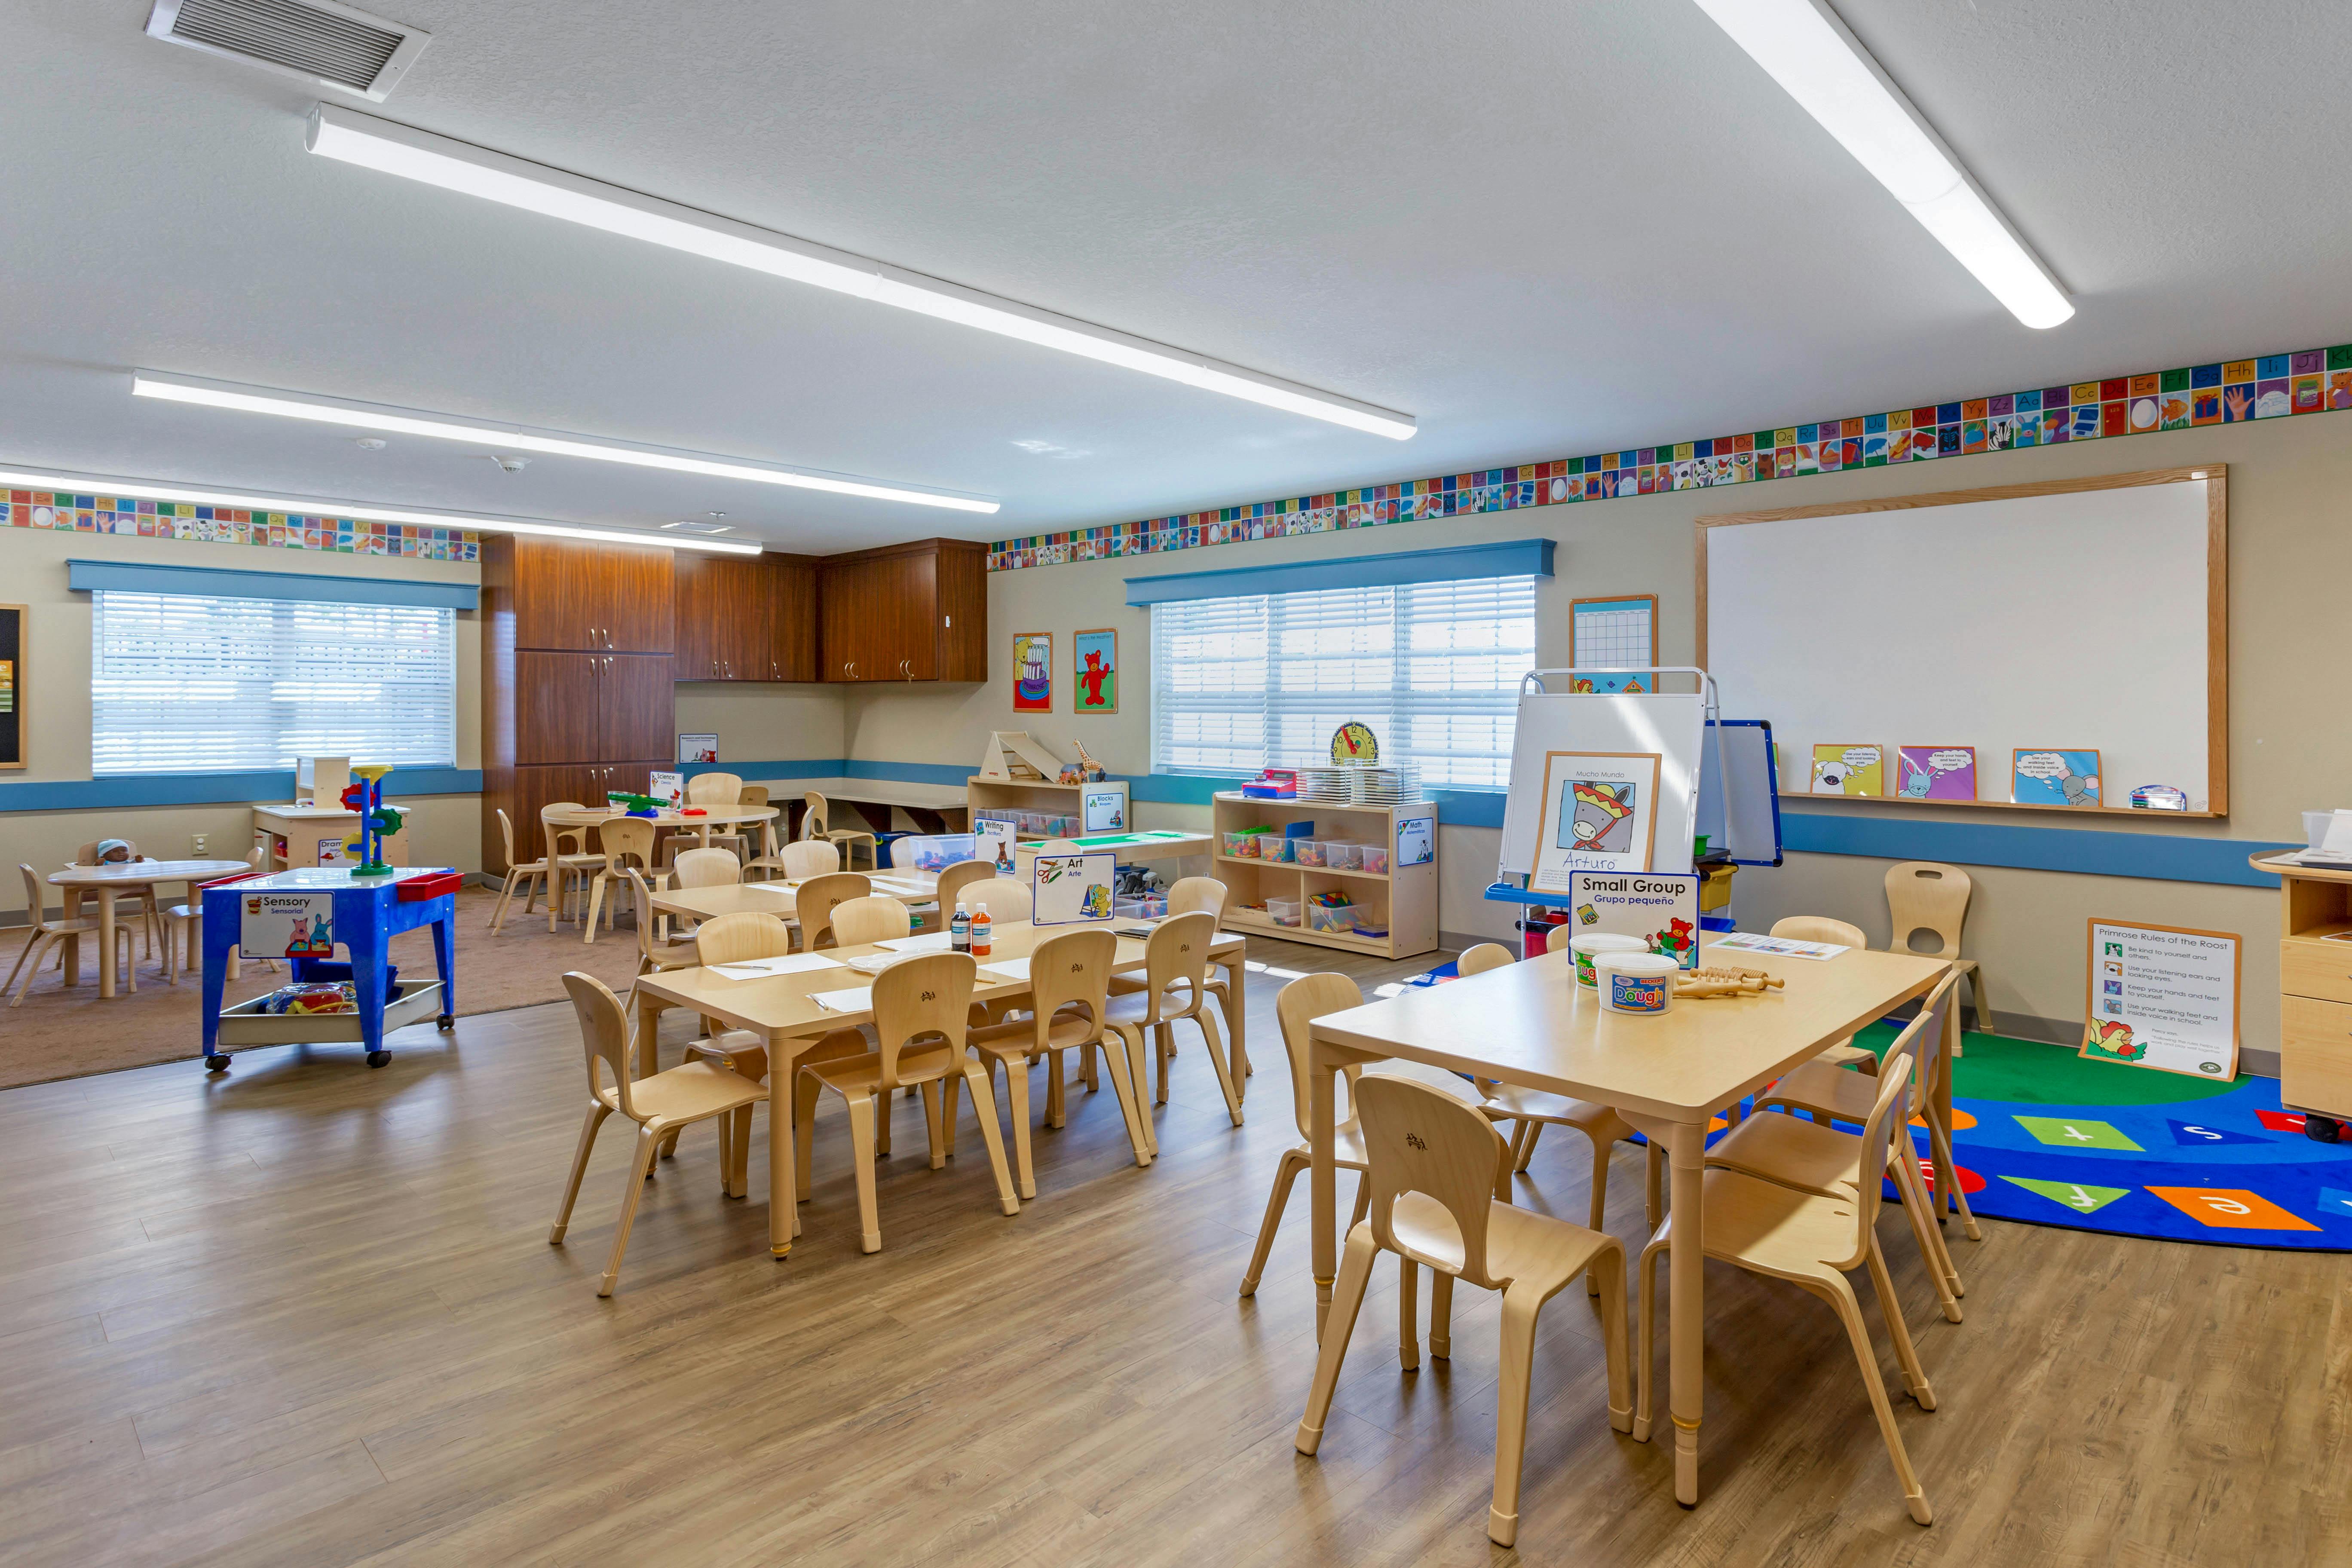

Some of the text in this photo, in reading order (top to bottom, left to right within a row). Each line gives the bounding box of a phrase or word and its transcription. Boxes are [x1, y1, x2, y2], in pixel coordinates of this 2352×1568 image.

[1521, 468, 1532, 477] Cc
[1553, 463, 1565, 472] Ee
[1604, 456, 1617, 466] Hh
[1736, 438, 1751, 447] Oo
[1757, 435, 1771, 445] Pp
[1776, 432, 1795, 444] Qq
[1800, 428, 1814, 438] Rr
[1823, 425, 1836, 435] Ss
[1845, 420, 1859, 431] Tt
[1868, 417, 1883, 429] Uu
[1893, 414, 1907, 425] Vv
[1914, 411, 1934, 421] Ww
[1966, 402, 1983, 417] Yy
[1992, 398, 2009, 411] Zz
[2018, 395, 2039, 406] Aa
[2075, 386, 2095, 398] Cc
[2104, 381, 2124, 395] Dd
[2135, 377, 2154, 391] Ee
[2165, 371, 2185, 386] Ff
[2194, 369, 2218, 386] Gg
[2228, 364, 2251, 377] Hh
[2267, 359, 2278, 372] Ii
[2297, 353, 2318, 372] Jj
[985, 821, 1004, 832] Writing
[1067, 858, 1083, 868] Art
[1562, 851, 1615, 870] Arturo
[1583, 877, 1627, 891] Small
[1633, 879, 1686, 896] Group
[263, 897, 310, 908] Sensory
[1594, 894, 1674, 906] Grupo pequeño
[2099, 928, 2138, 940] Primrose
[2141, 933, 2165, 943] Rules
[2181, 937, 2197, 946] the
[2200, 940, 2228, 950] Roost
[2128, 972, 2153, 981] looking
[2159, 969, 2187, 978] listening
[1614, 985, 1663, 1006] Dough
[2136, 992, 2165, 1001] yourself.
[2165, 989, 2187, 997] hands
[2158, 1008, 2185, 1017] walking
[2177, 1017, 2203, 1026] school.
